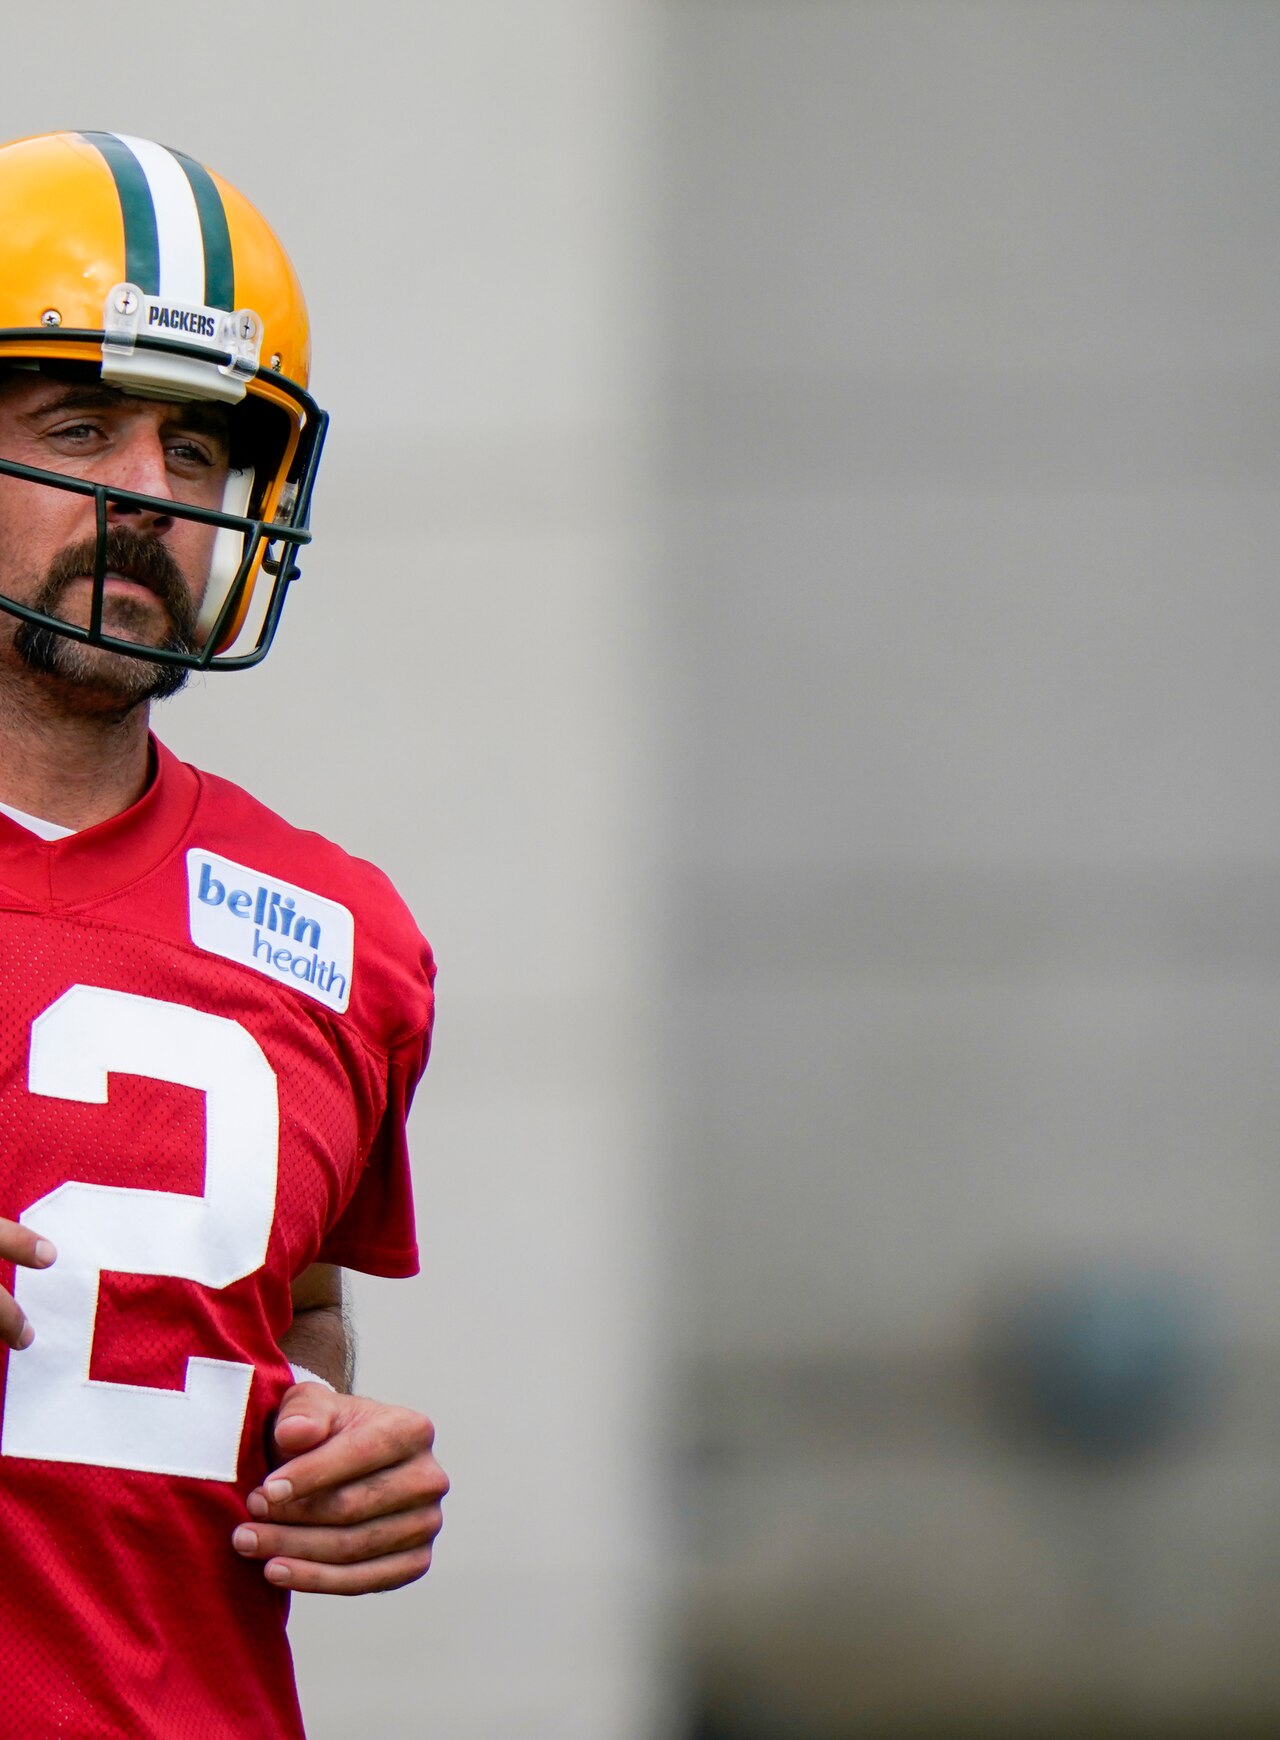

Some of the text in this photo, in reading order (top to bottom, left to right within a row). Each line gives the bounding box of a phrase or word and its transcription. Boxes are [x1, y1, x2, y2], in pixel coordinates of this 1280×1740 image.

[148, 306, 215, 337] PACKERS
[198, 863, 321, 950] bellin
[253, 929, 346, 999] health
